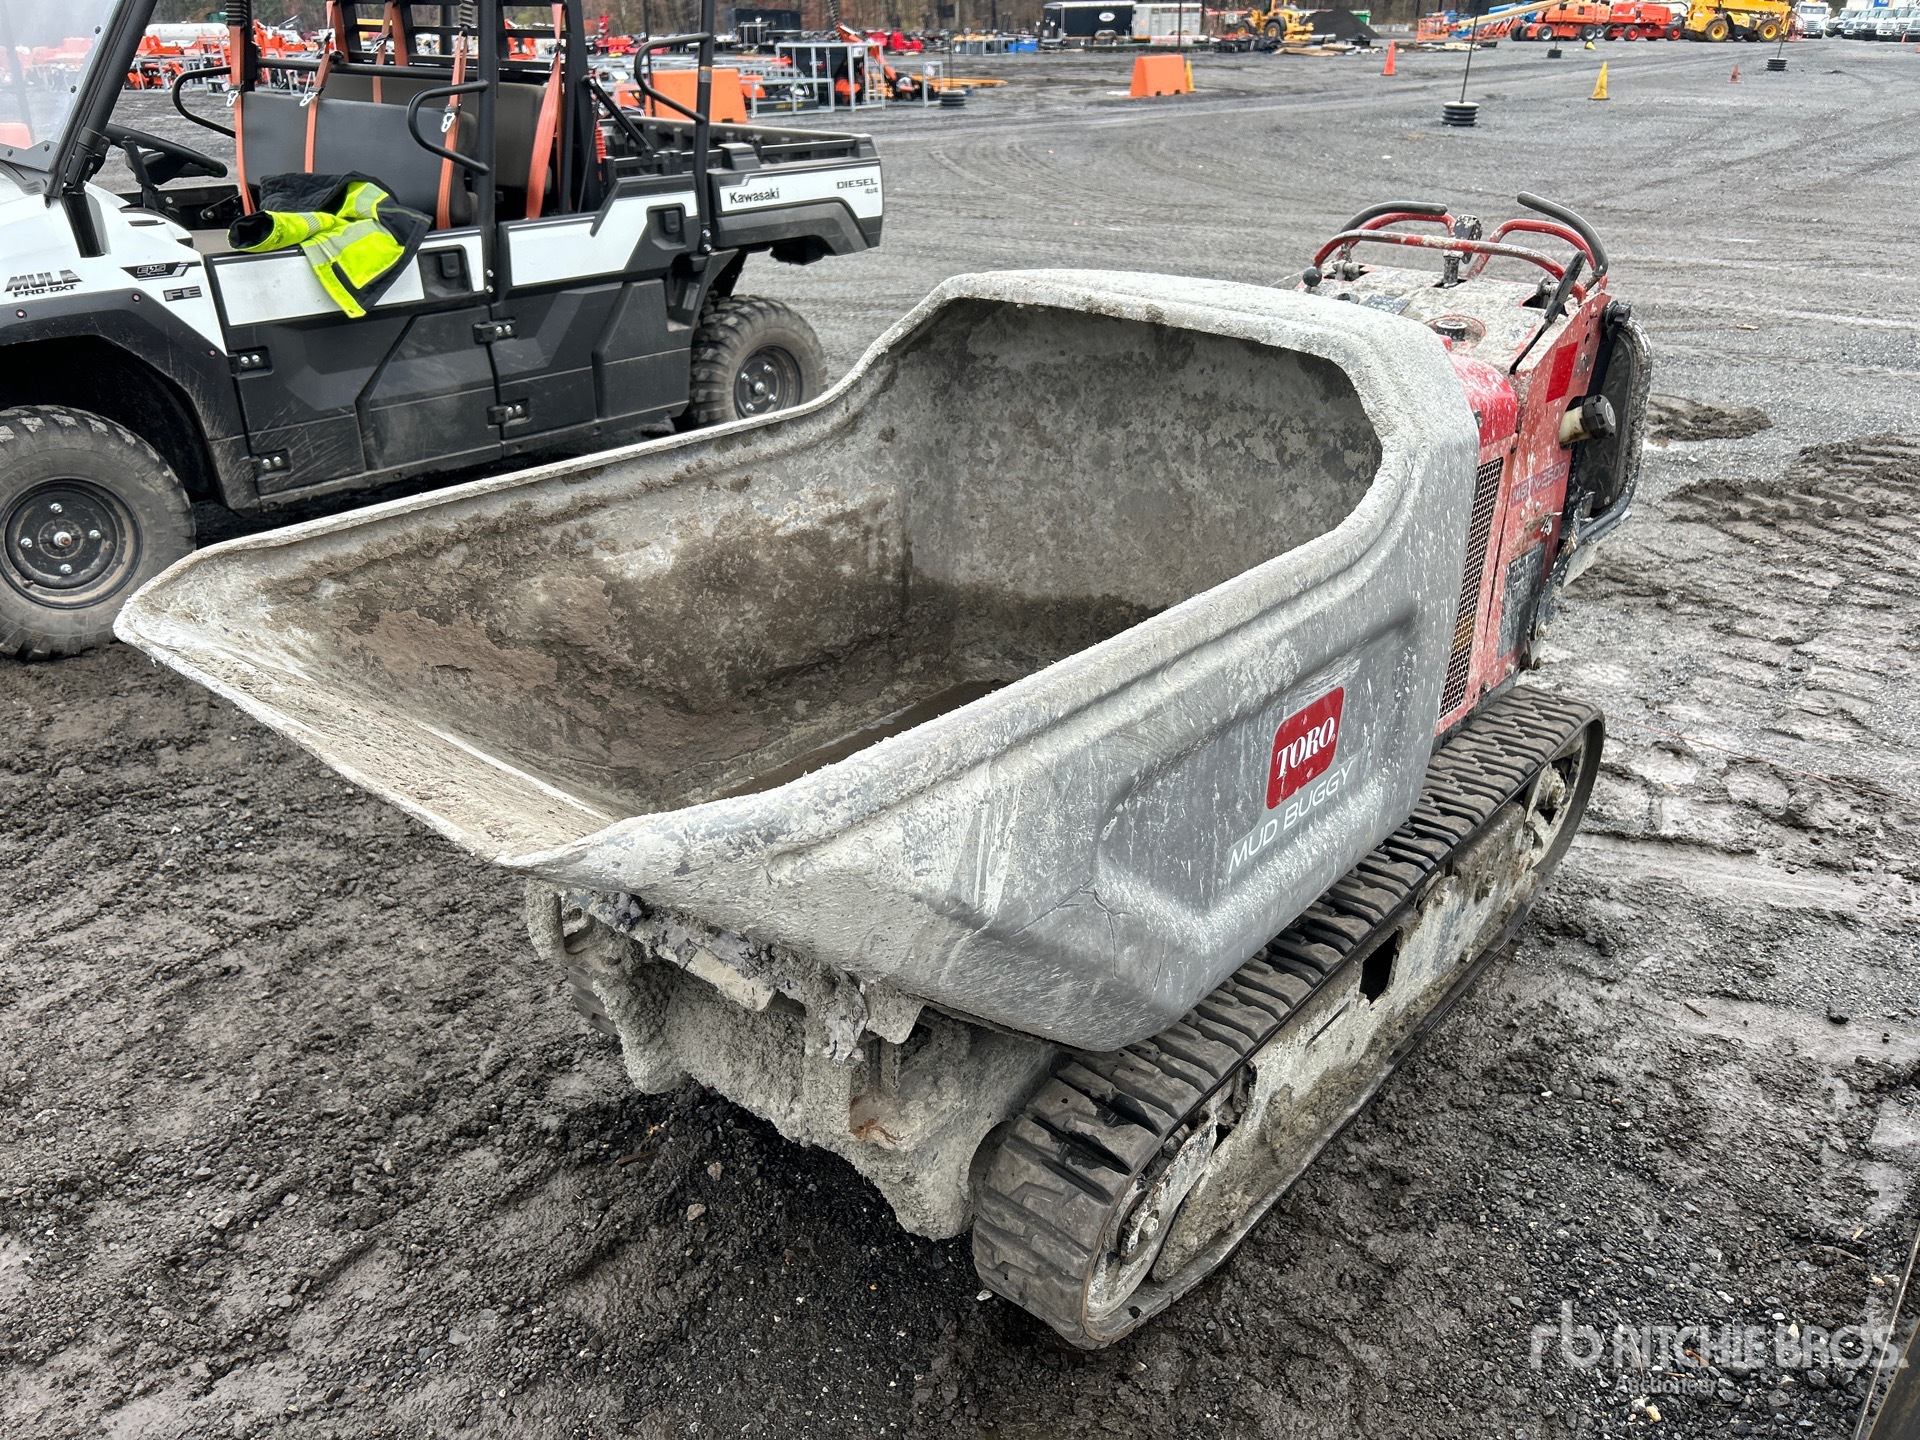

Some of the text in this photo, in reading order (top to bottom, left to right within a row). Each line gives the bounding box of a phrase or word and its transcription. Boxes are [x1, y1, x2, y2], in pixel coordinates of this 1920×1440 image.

[836, 178, 878, 189] DIESEL
[729, 187, 780, 204] Kawasaki
[4, 269, 83, 292] MULE
[13, 284, 77, 298] PRO-DXT
[164, 287, 201, 300] FE
[1276, 717, 1335, 780] TORO
[1228, 760, 1355, 874] MUD BUGGY
